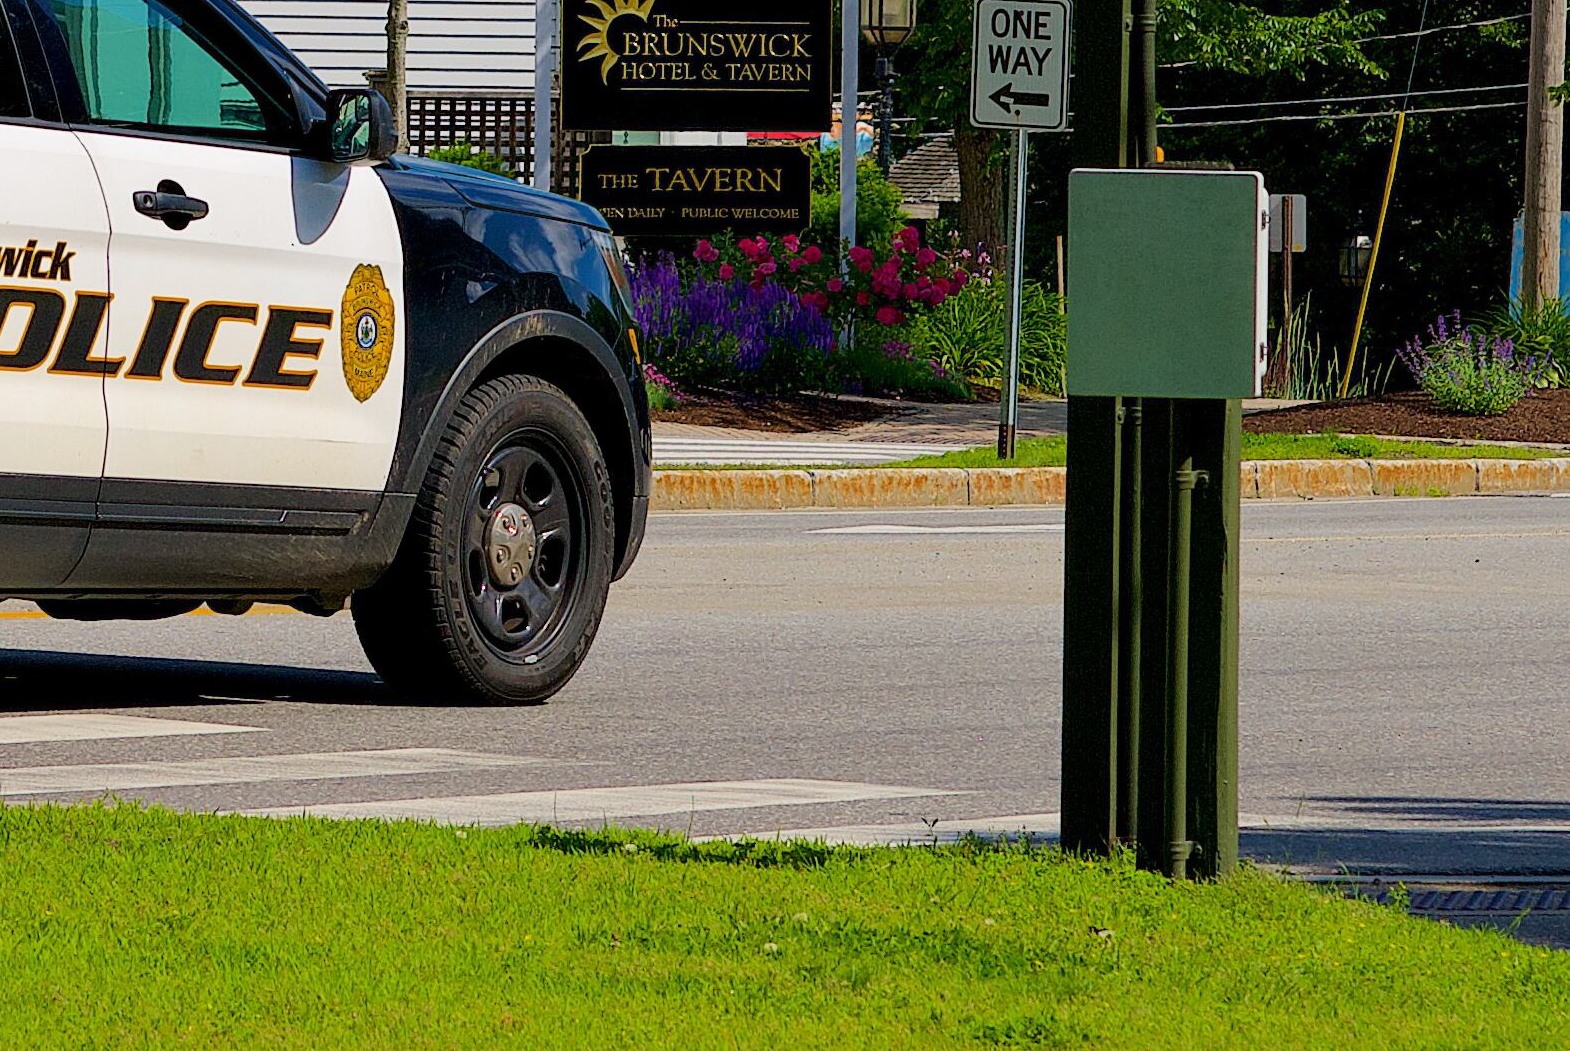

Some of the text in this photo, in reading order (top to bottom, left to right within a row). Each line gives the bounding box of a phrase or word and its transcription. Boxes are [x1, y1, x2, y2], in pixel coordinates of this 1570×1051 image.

[653, 14, 678, 28] The
[991, 9, 1052, 40] ONE
[622, 32, 812, 58] BRUNSWICK
[621, 62, 811, 82] HOTEL & TAVERN
[988, 45, 1053, 77] WAY
[598, 168, 782, 192] THE TAVERN
[628, 208, 666, 219] DAILY
[681, 208, 729, 219] PUBLIC
[732, 208, 800, 220] WELCOME
